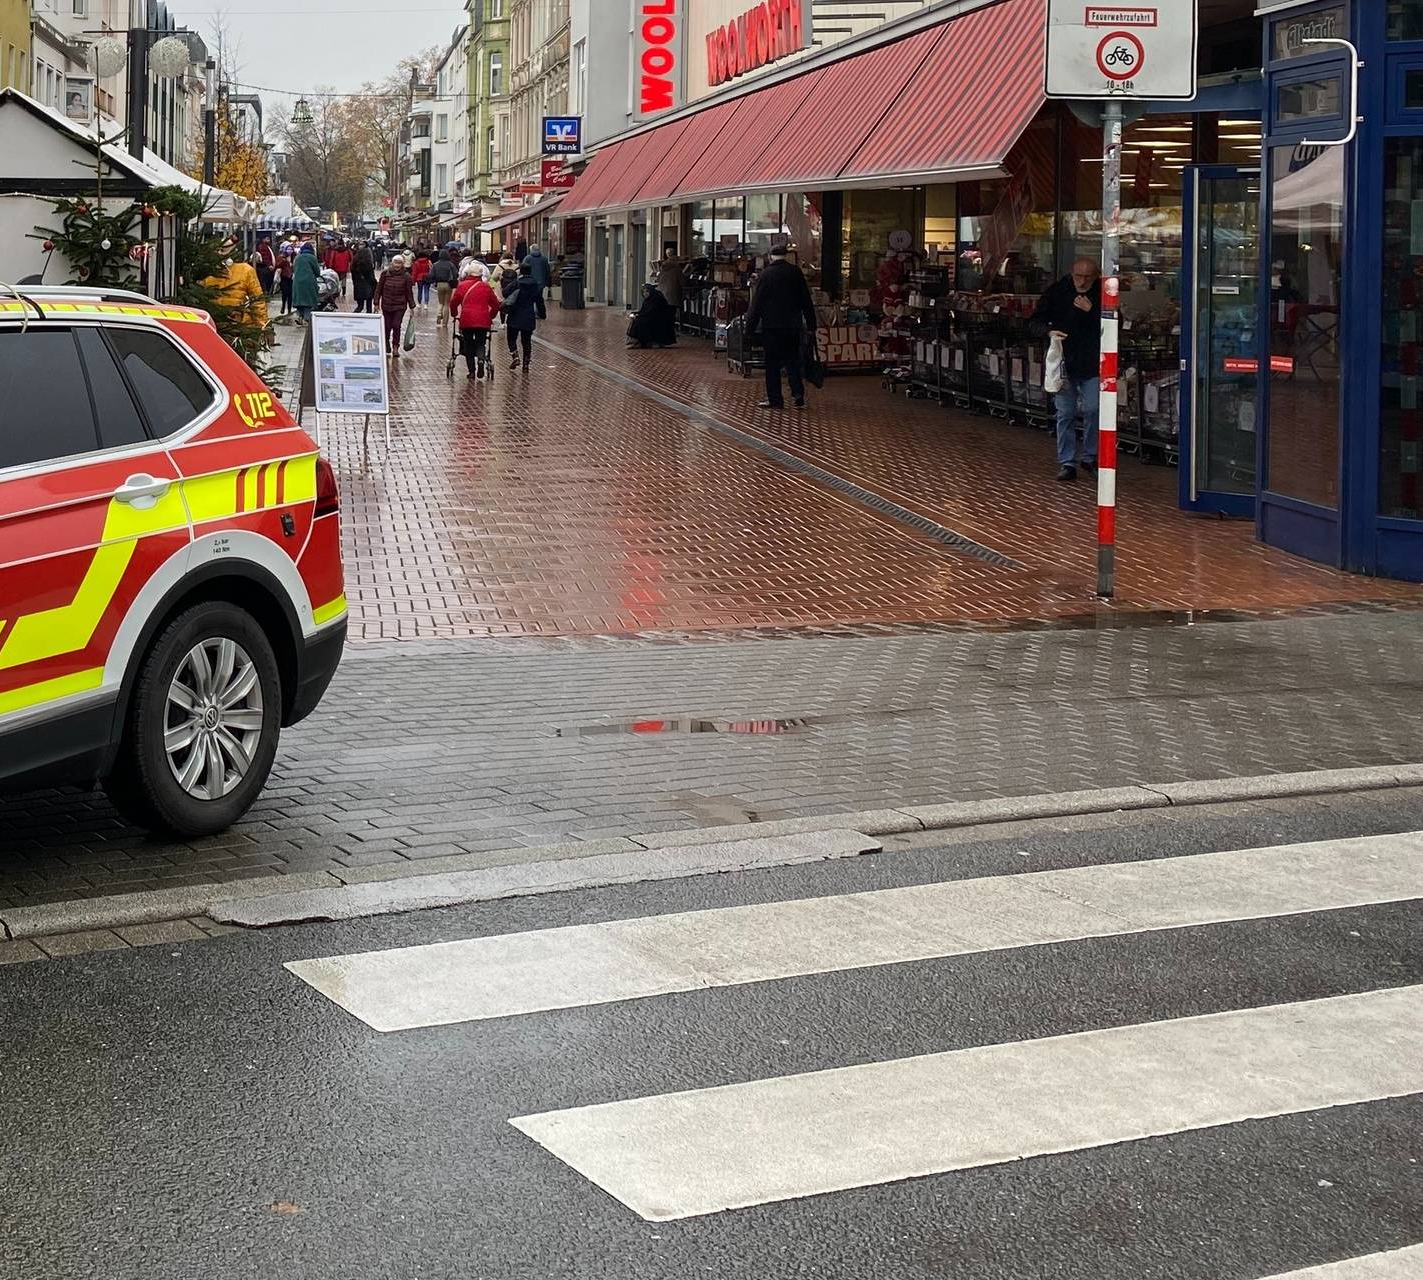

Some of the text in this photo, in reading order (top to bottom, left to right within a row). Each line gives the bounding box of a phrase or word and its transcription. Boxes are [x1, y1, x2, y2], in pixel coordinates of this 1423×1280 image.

[1091, 11, 1151, 22] Feuerwehrzufahrt
[705, 0, 802, 87] WOOLWORTH
[545, 143, 577, 152] VR Bank
[245, 392, 276, 419] 112
